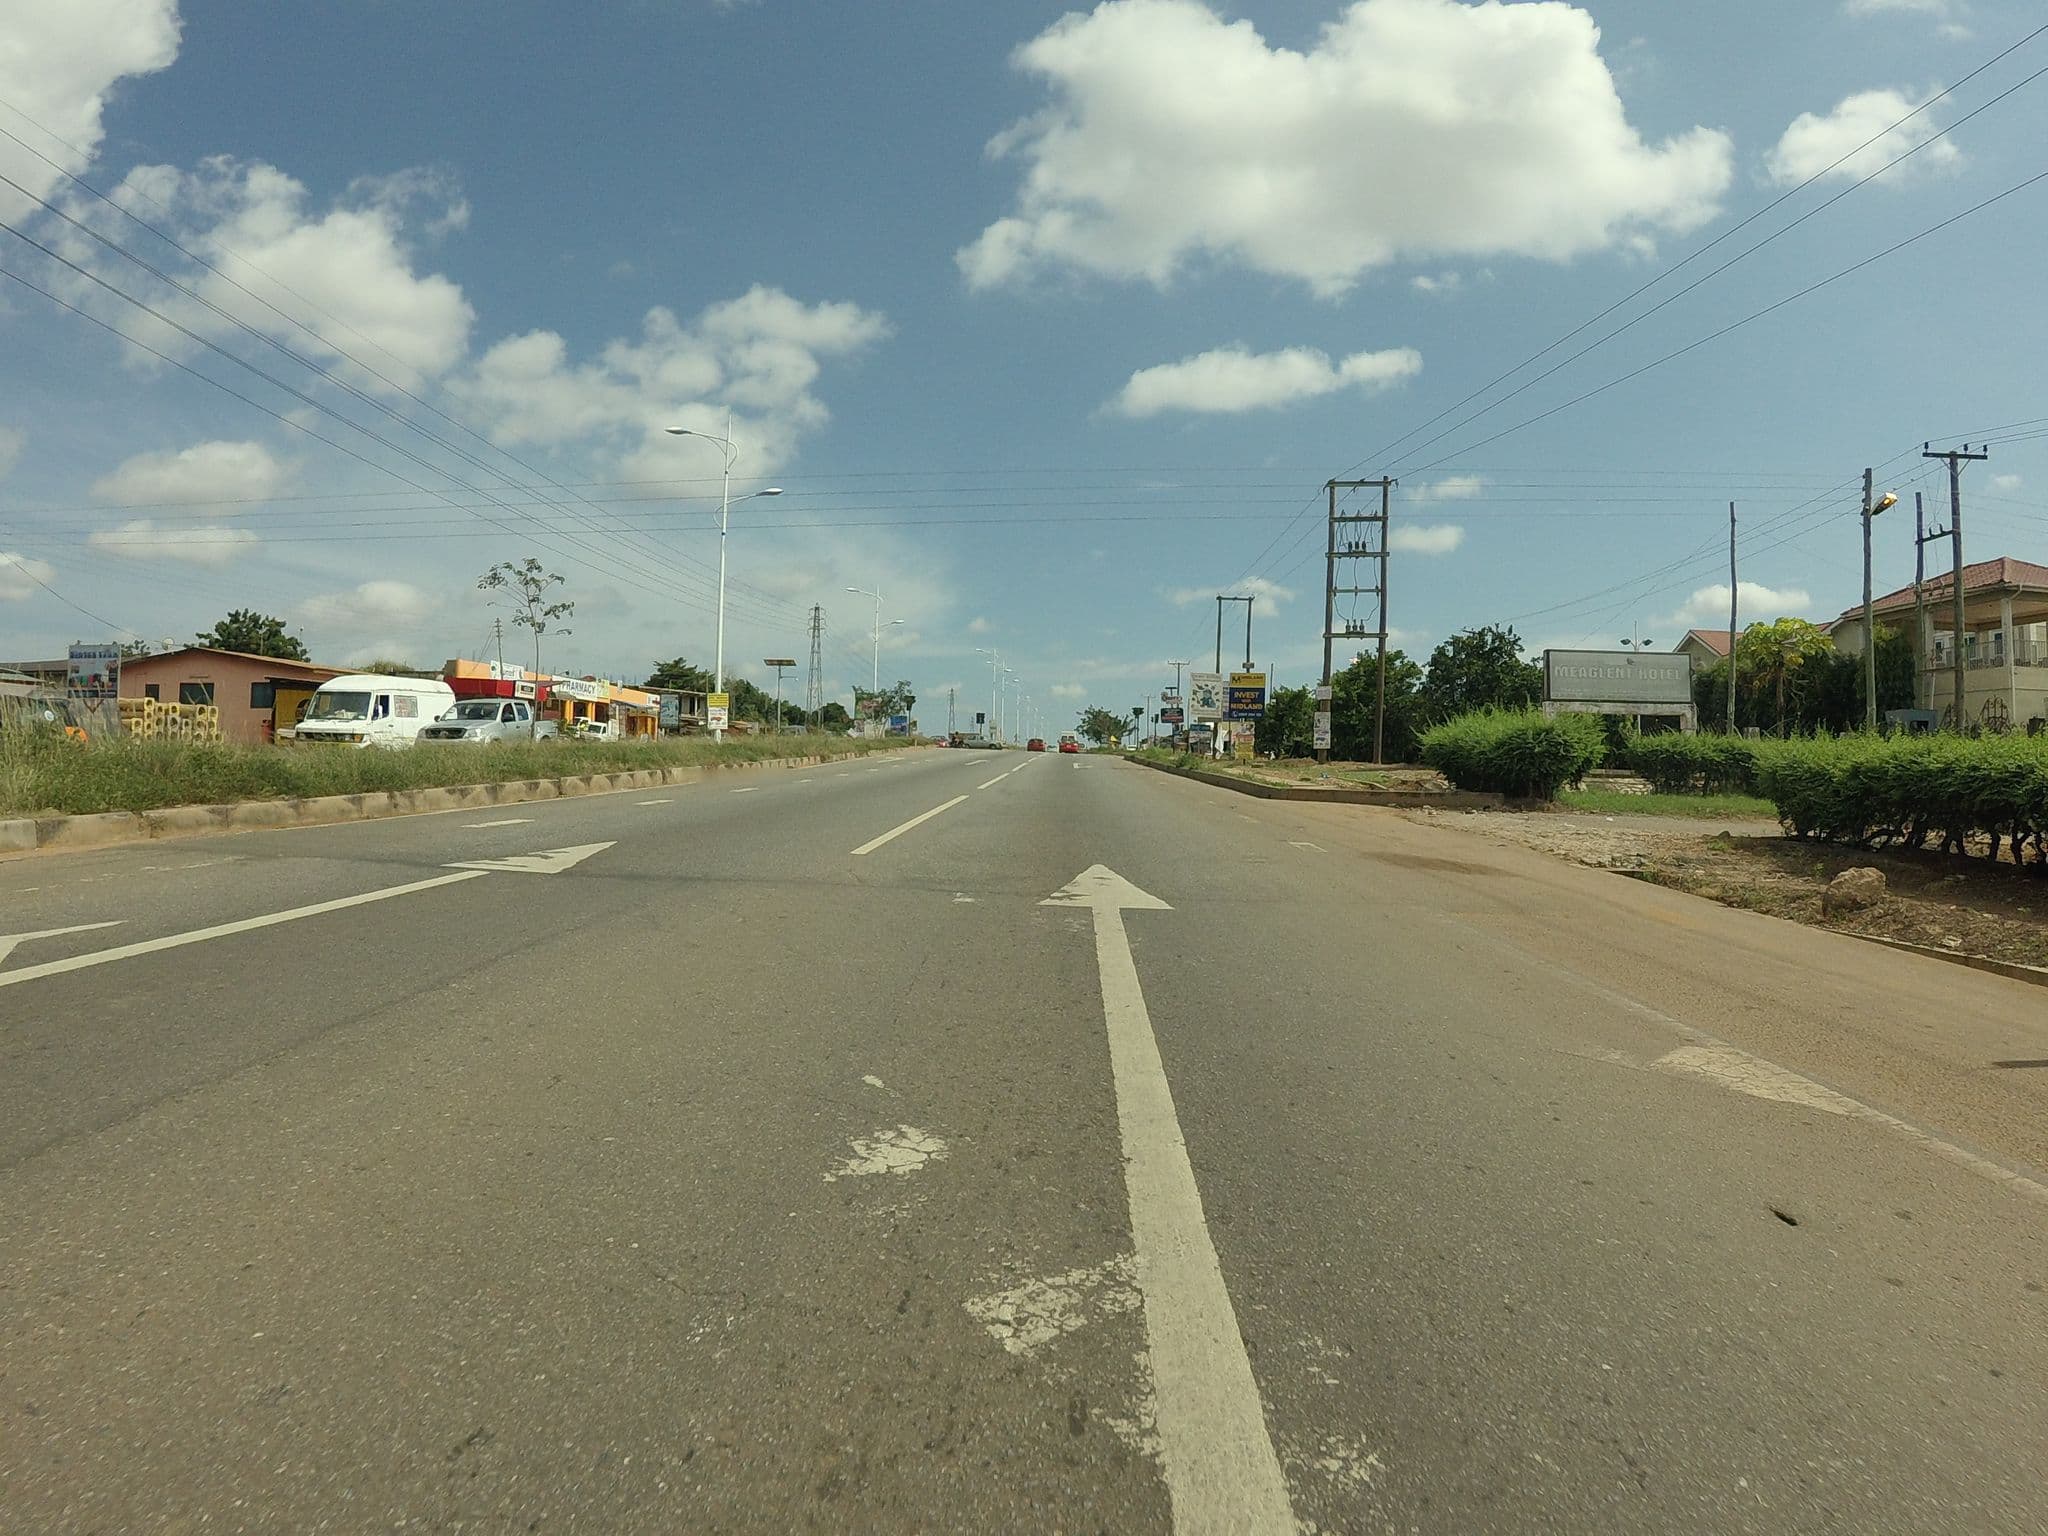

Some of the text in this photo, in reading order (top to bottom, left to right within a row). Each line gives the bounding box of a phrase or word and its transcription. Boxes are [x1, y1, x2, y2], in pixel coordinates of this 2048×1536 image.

[1638, 668, 1681, 681] HOTEL
[562, 681, 596, 694] PHARMACY
[1234, 691, 1260, 699] INVEST
